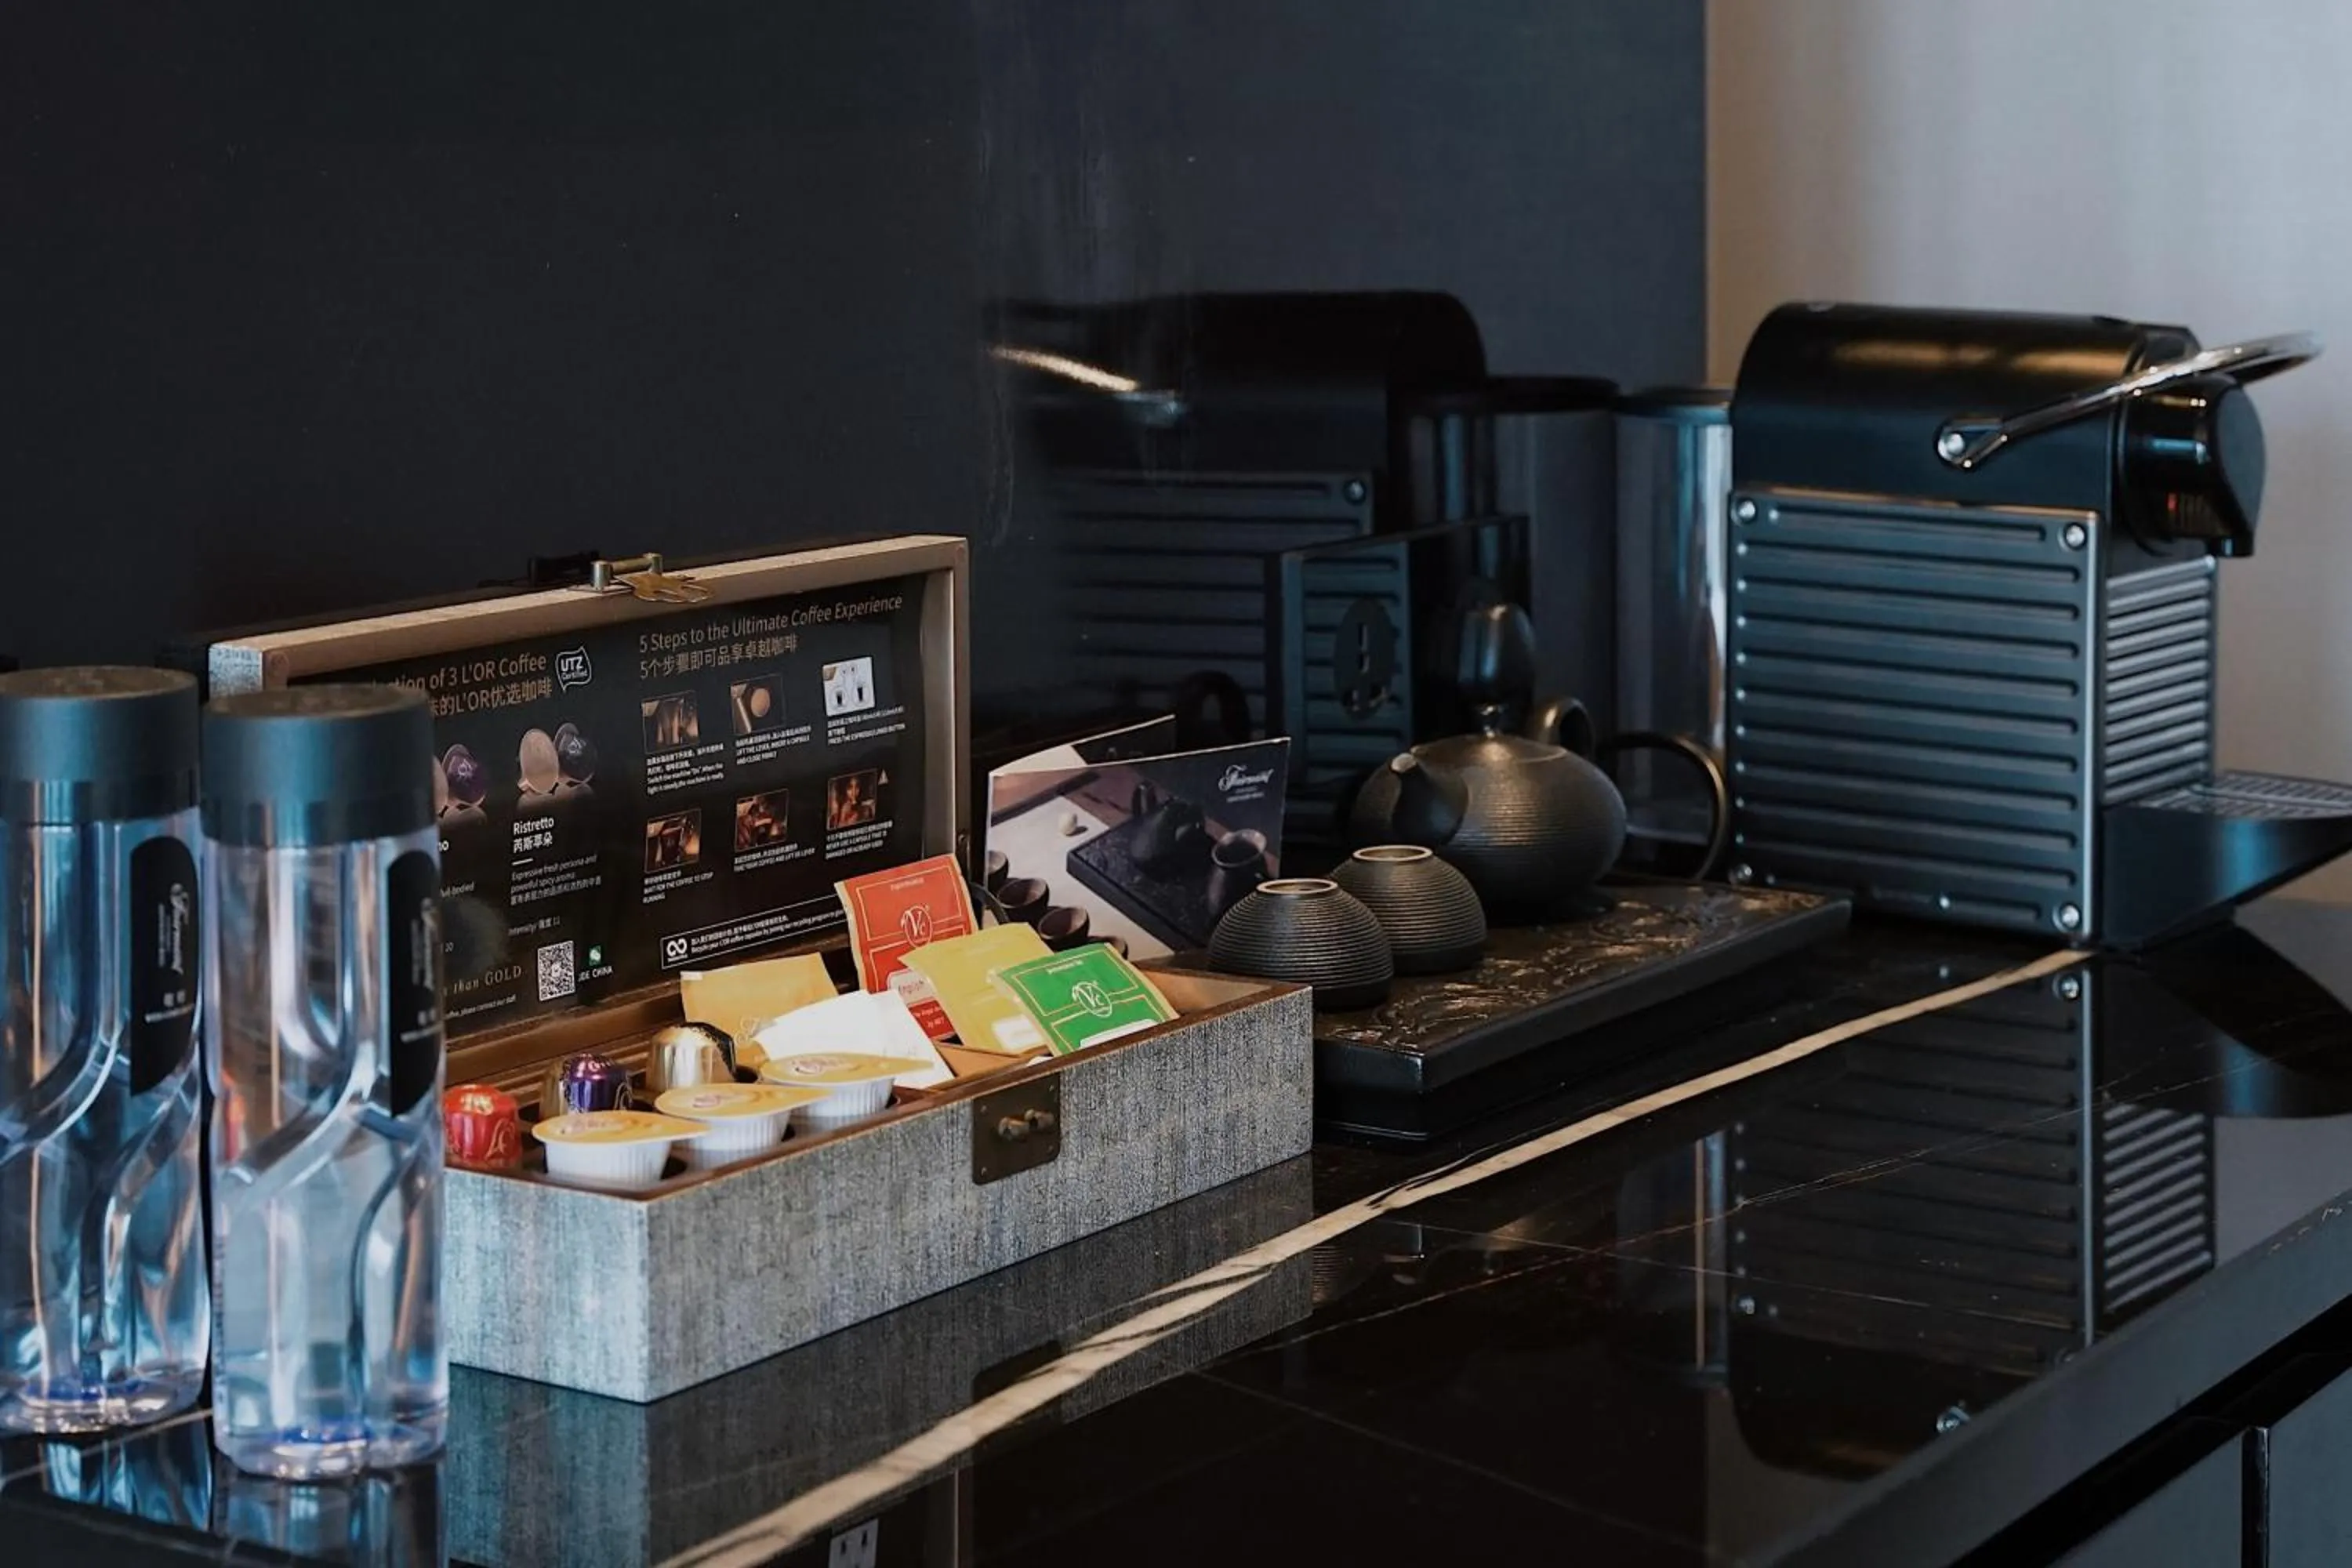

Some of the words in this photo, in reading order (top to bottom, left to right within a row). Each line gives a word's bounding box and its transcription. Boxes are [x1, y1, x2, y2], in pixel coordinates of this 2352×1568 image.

[639, 636, 648, 653] 5
[650, 631, 688, 652] Steps
[691, 627, 705, 644] to
[707, 623, 729, 641] the
[732, 612, 789, 637] Ultimate
[791, 603, 832, 625] Coffee
[835, 594, 903, 620] Experience
[429, 667, 446, 690] of
[448, 666, 458, 687] 3
[462, 660, 495, 684] L'OR
[499, 652, 547, 676] Coffee
[561, 655, 584, 672] UTZ
[514, 817, 554, 835] Ristretto
[454, 978, 479, 995] than
[485, 965, 521, 985] GOLD
